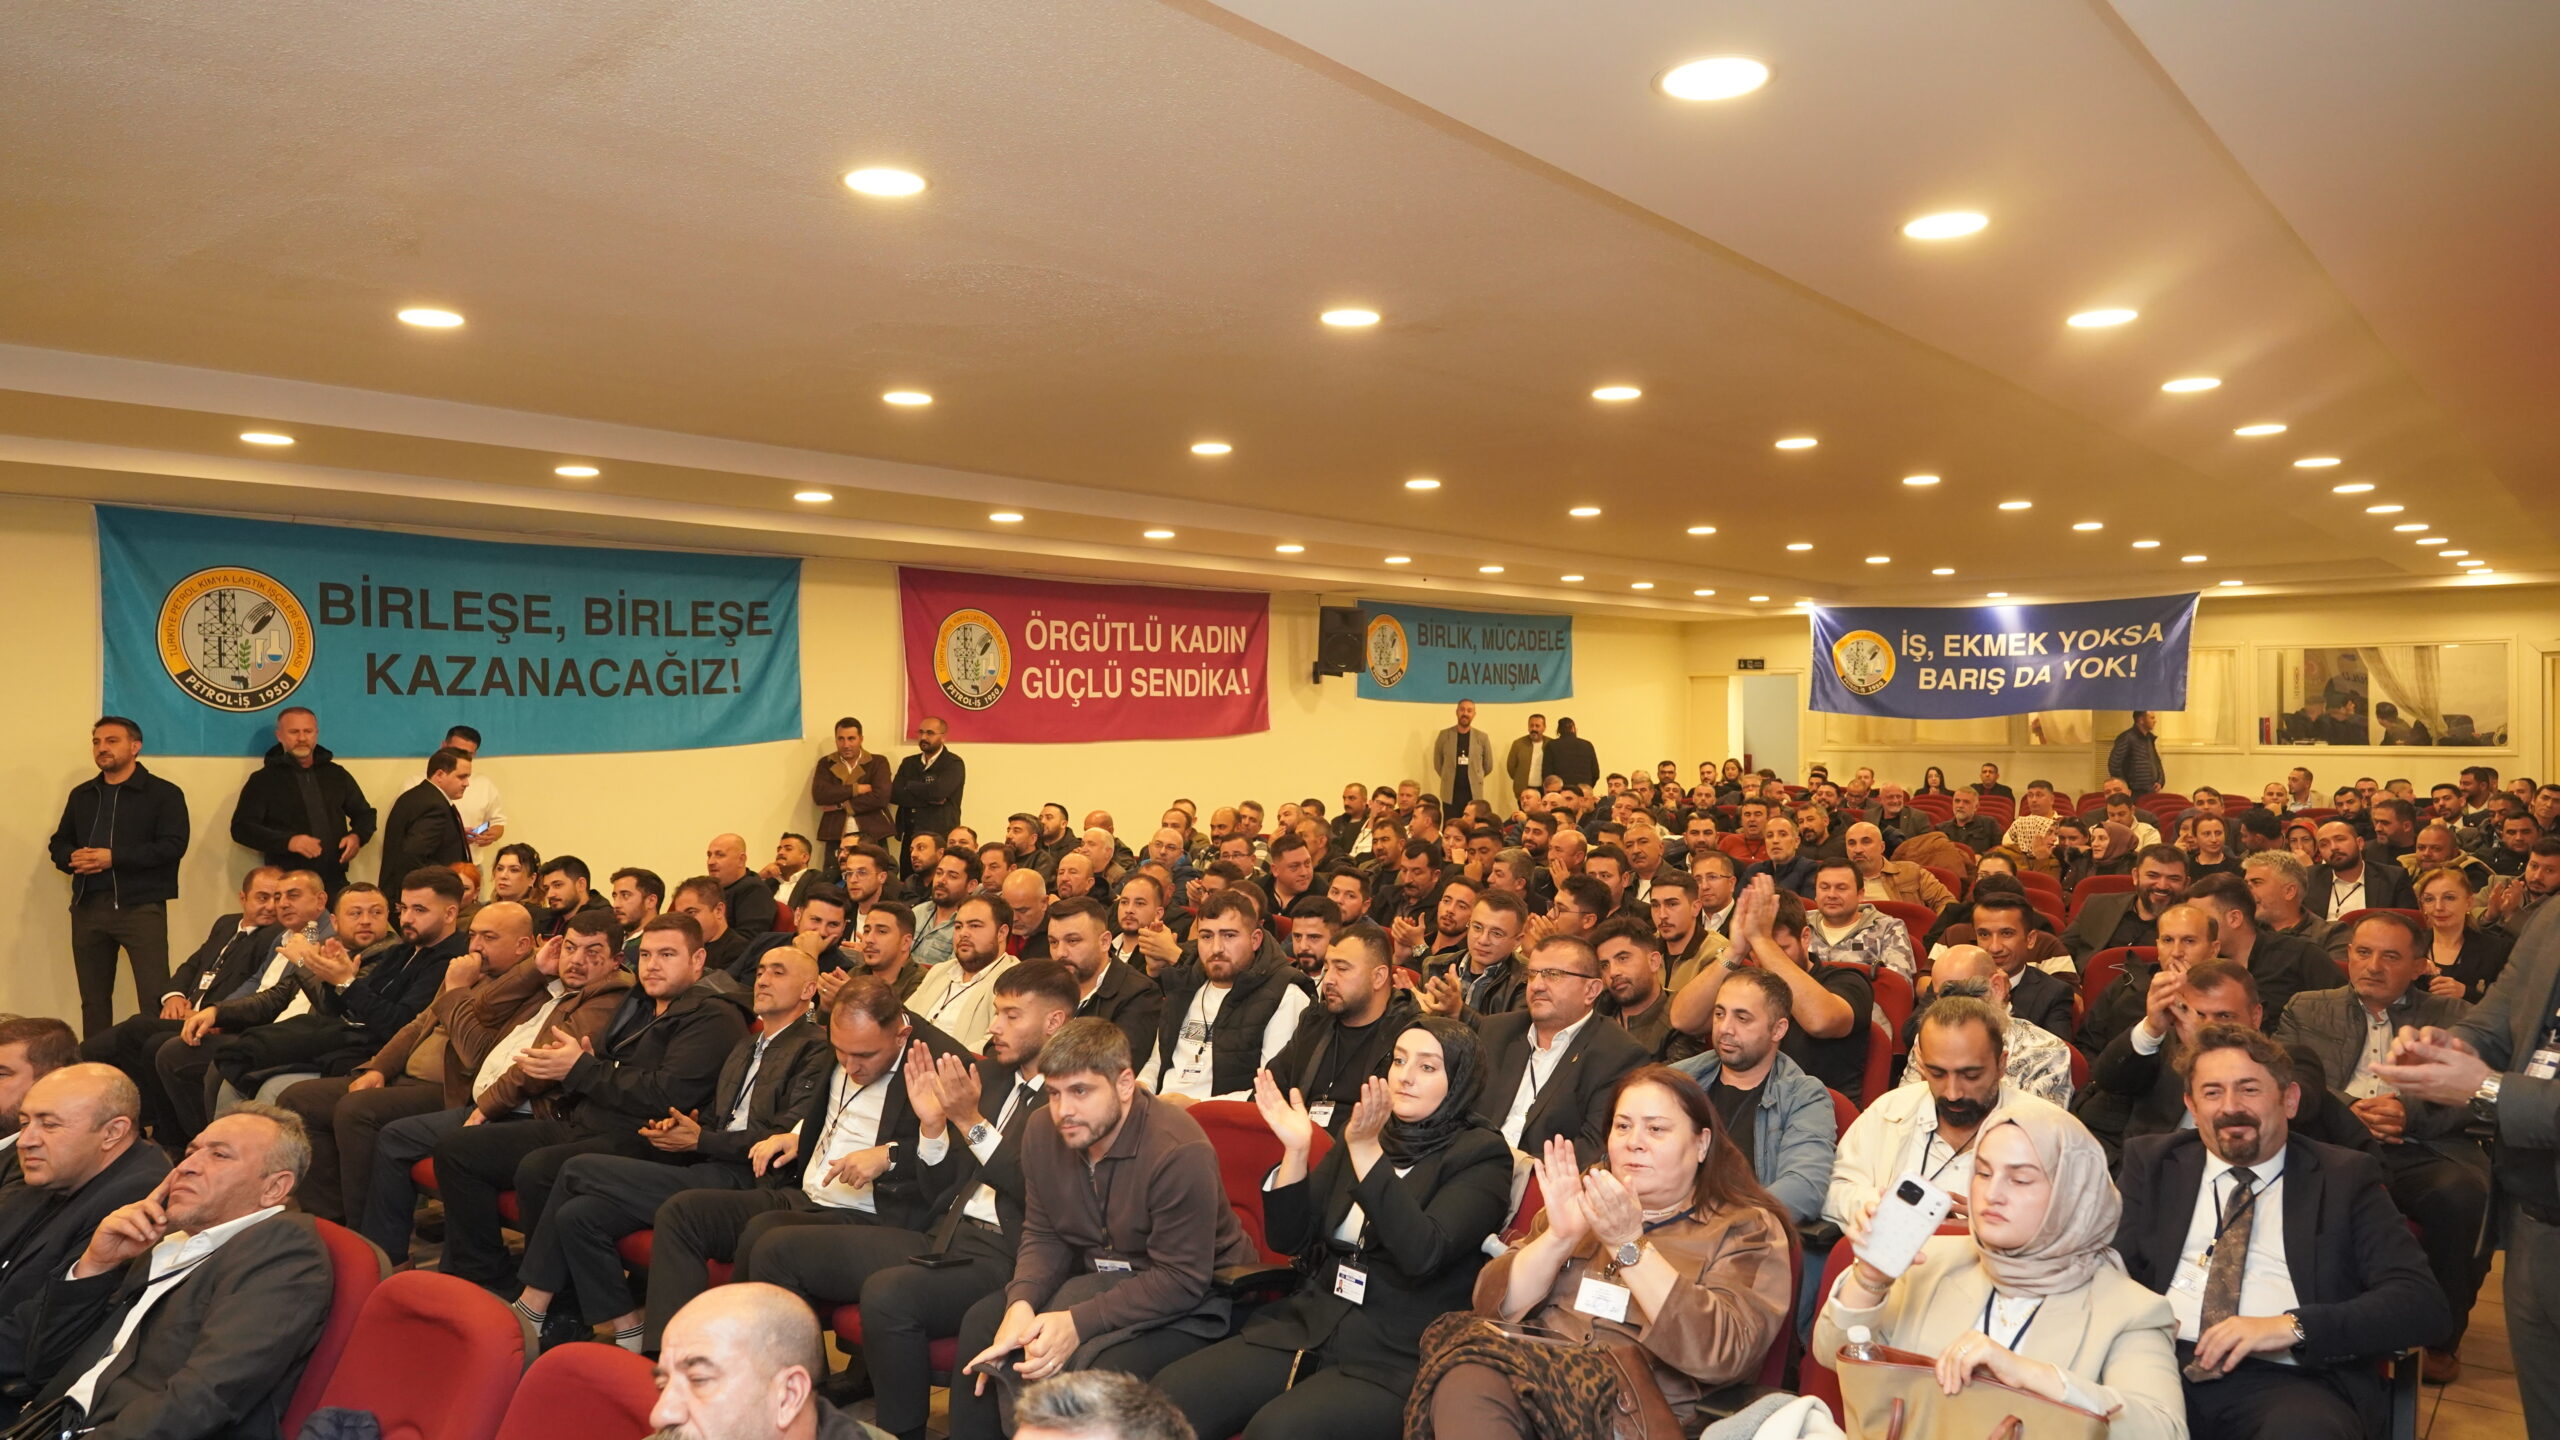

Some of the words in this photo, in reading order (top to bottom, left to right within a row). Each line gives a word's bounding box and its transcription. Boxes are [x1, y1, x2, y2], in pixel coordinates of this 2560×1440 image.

[171, 586, 198, 614] PETROL
[198, 575, 230, 588] KİMYA
[319, 575, 566, 645] BİRLEŞE,
[584, 589, 773, 647] BİRLEŞE
[1025, 610, 1162, 653] ÖRGÜTLÜ
[1170, 624, 1247, 653] KADIN
[1417, 619, 1477, 654] BİRLİK,
[1482, 623, 1566, 651] MÜCADELE
[1901, 629, 1934, 662] İŞ,
[1943, 631, 2048, 657] EKMEK
[2058, 622, 2164, 653] YOKSA
[185, 675, 251, 708] PETROL-İŞ
[258, 680, 290, 703] 1950
[366, 650, 742, 697] KAZANACAĞIZ!
[1021, 659, 1123, 707] GÜÇLÜ
[1130, 662, 1251, 697] SENDİKA!
[1447, 661, 1541, 691] DAYANIŞMA
[1918, 667, 2006, 695] BARIŞ
[2013, 665, 2051, 688] DA
[2063, 654, 2138, 680] YOK!
[984, 688, 1000, 704] 1950
